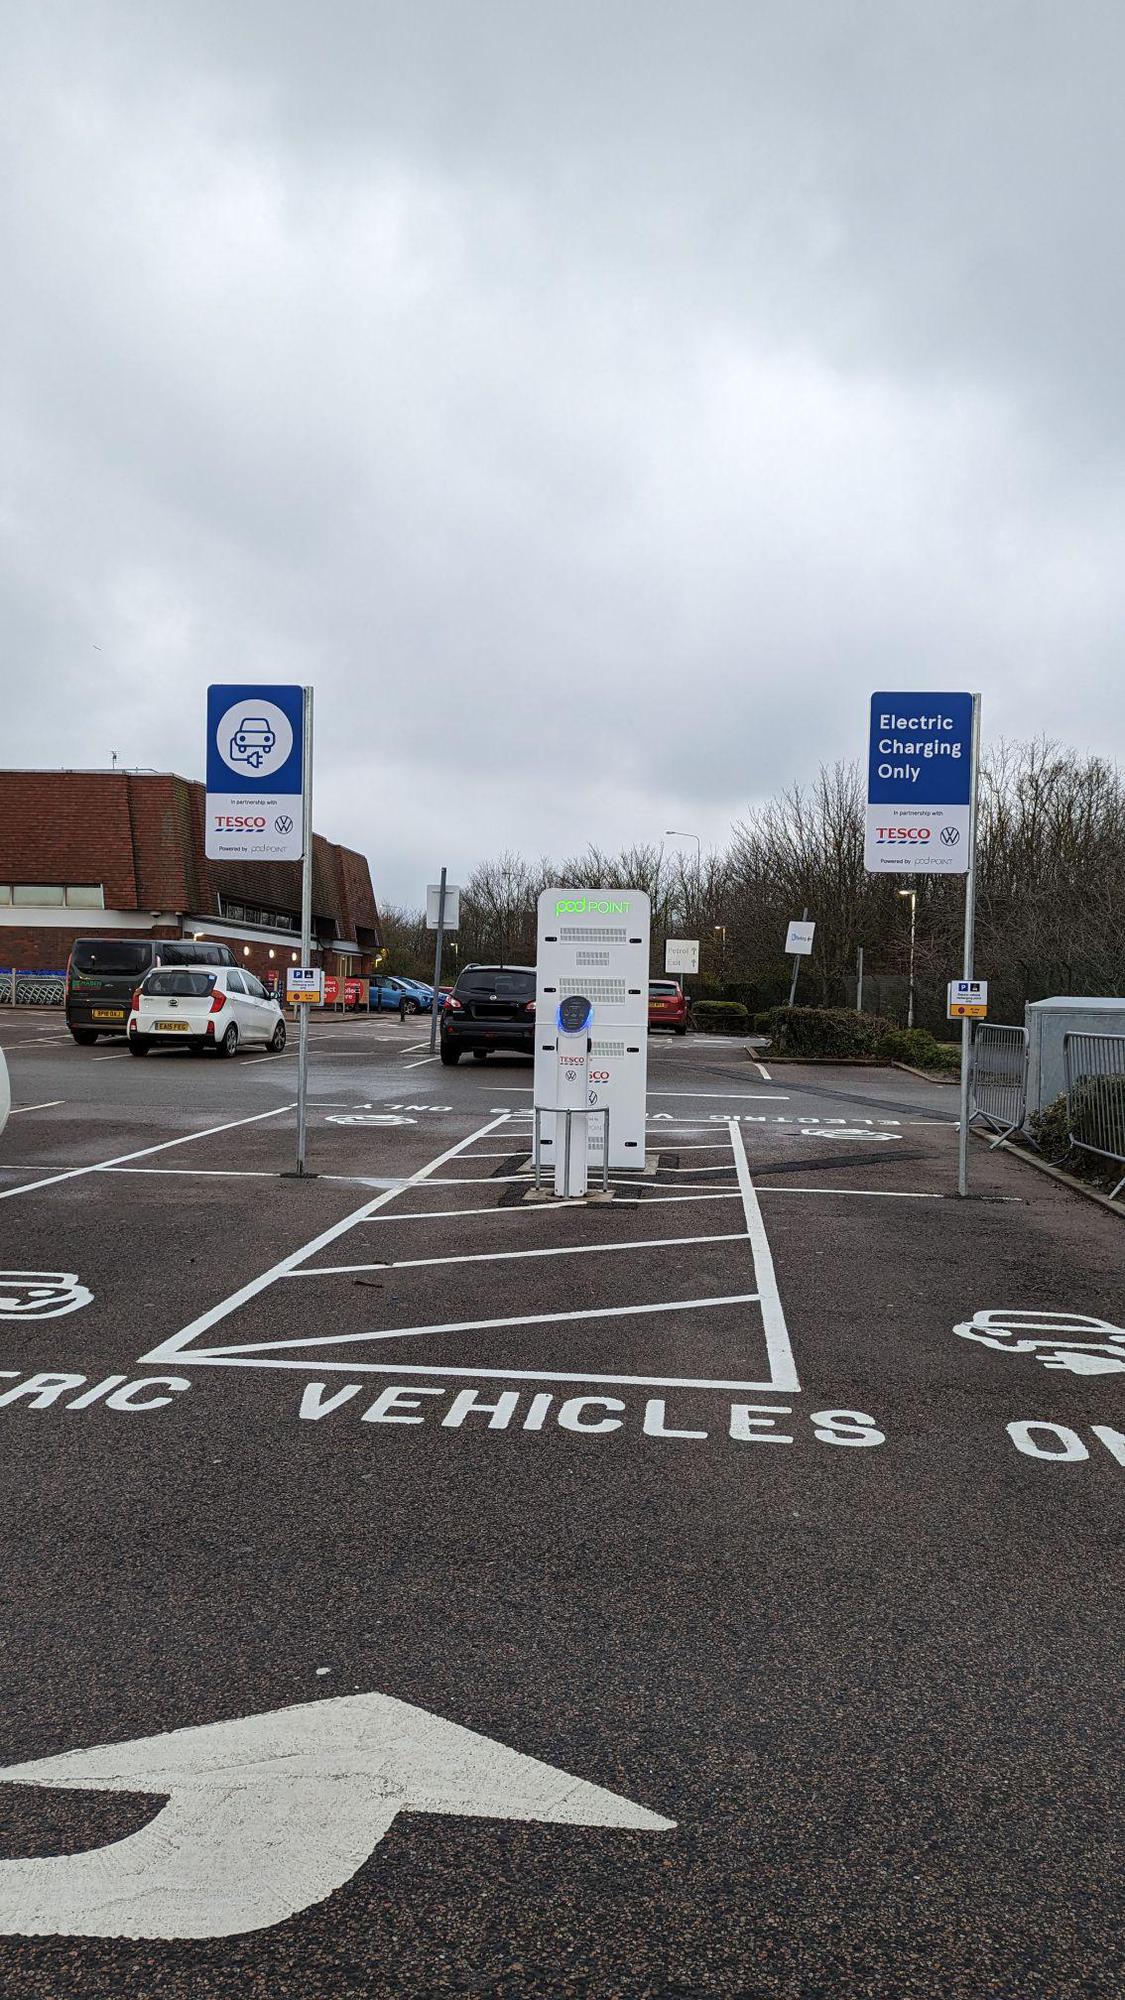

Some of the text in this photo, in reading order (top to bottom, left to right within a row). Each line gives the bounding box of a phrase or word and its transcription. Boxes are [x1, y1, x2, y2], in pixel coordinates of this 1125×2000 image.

[880, 714, 953, 730] Electric
[878, 739, 962, 758] Charging
[878, 763, 921, 782] Only
[214, 816, 267, 828] TESCO
[875, 827, 931, 839] TESCO
[241, 845, 248, 853] by
[556, 896, 632, 917] pod POINT
[299, 1382, 886, 1448] VEHICLES
